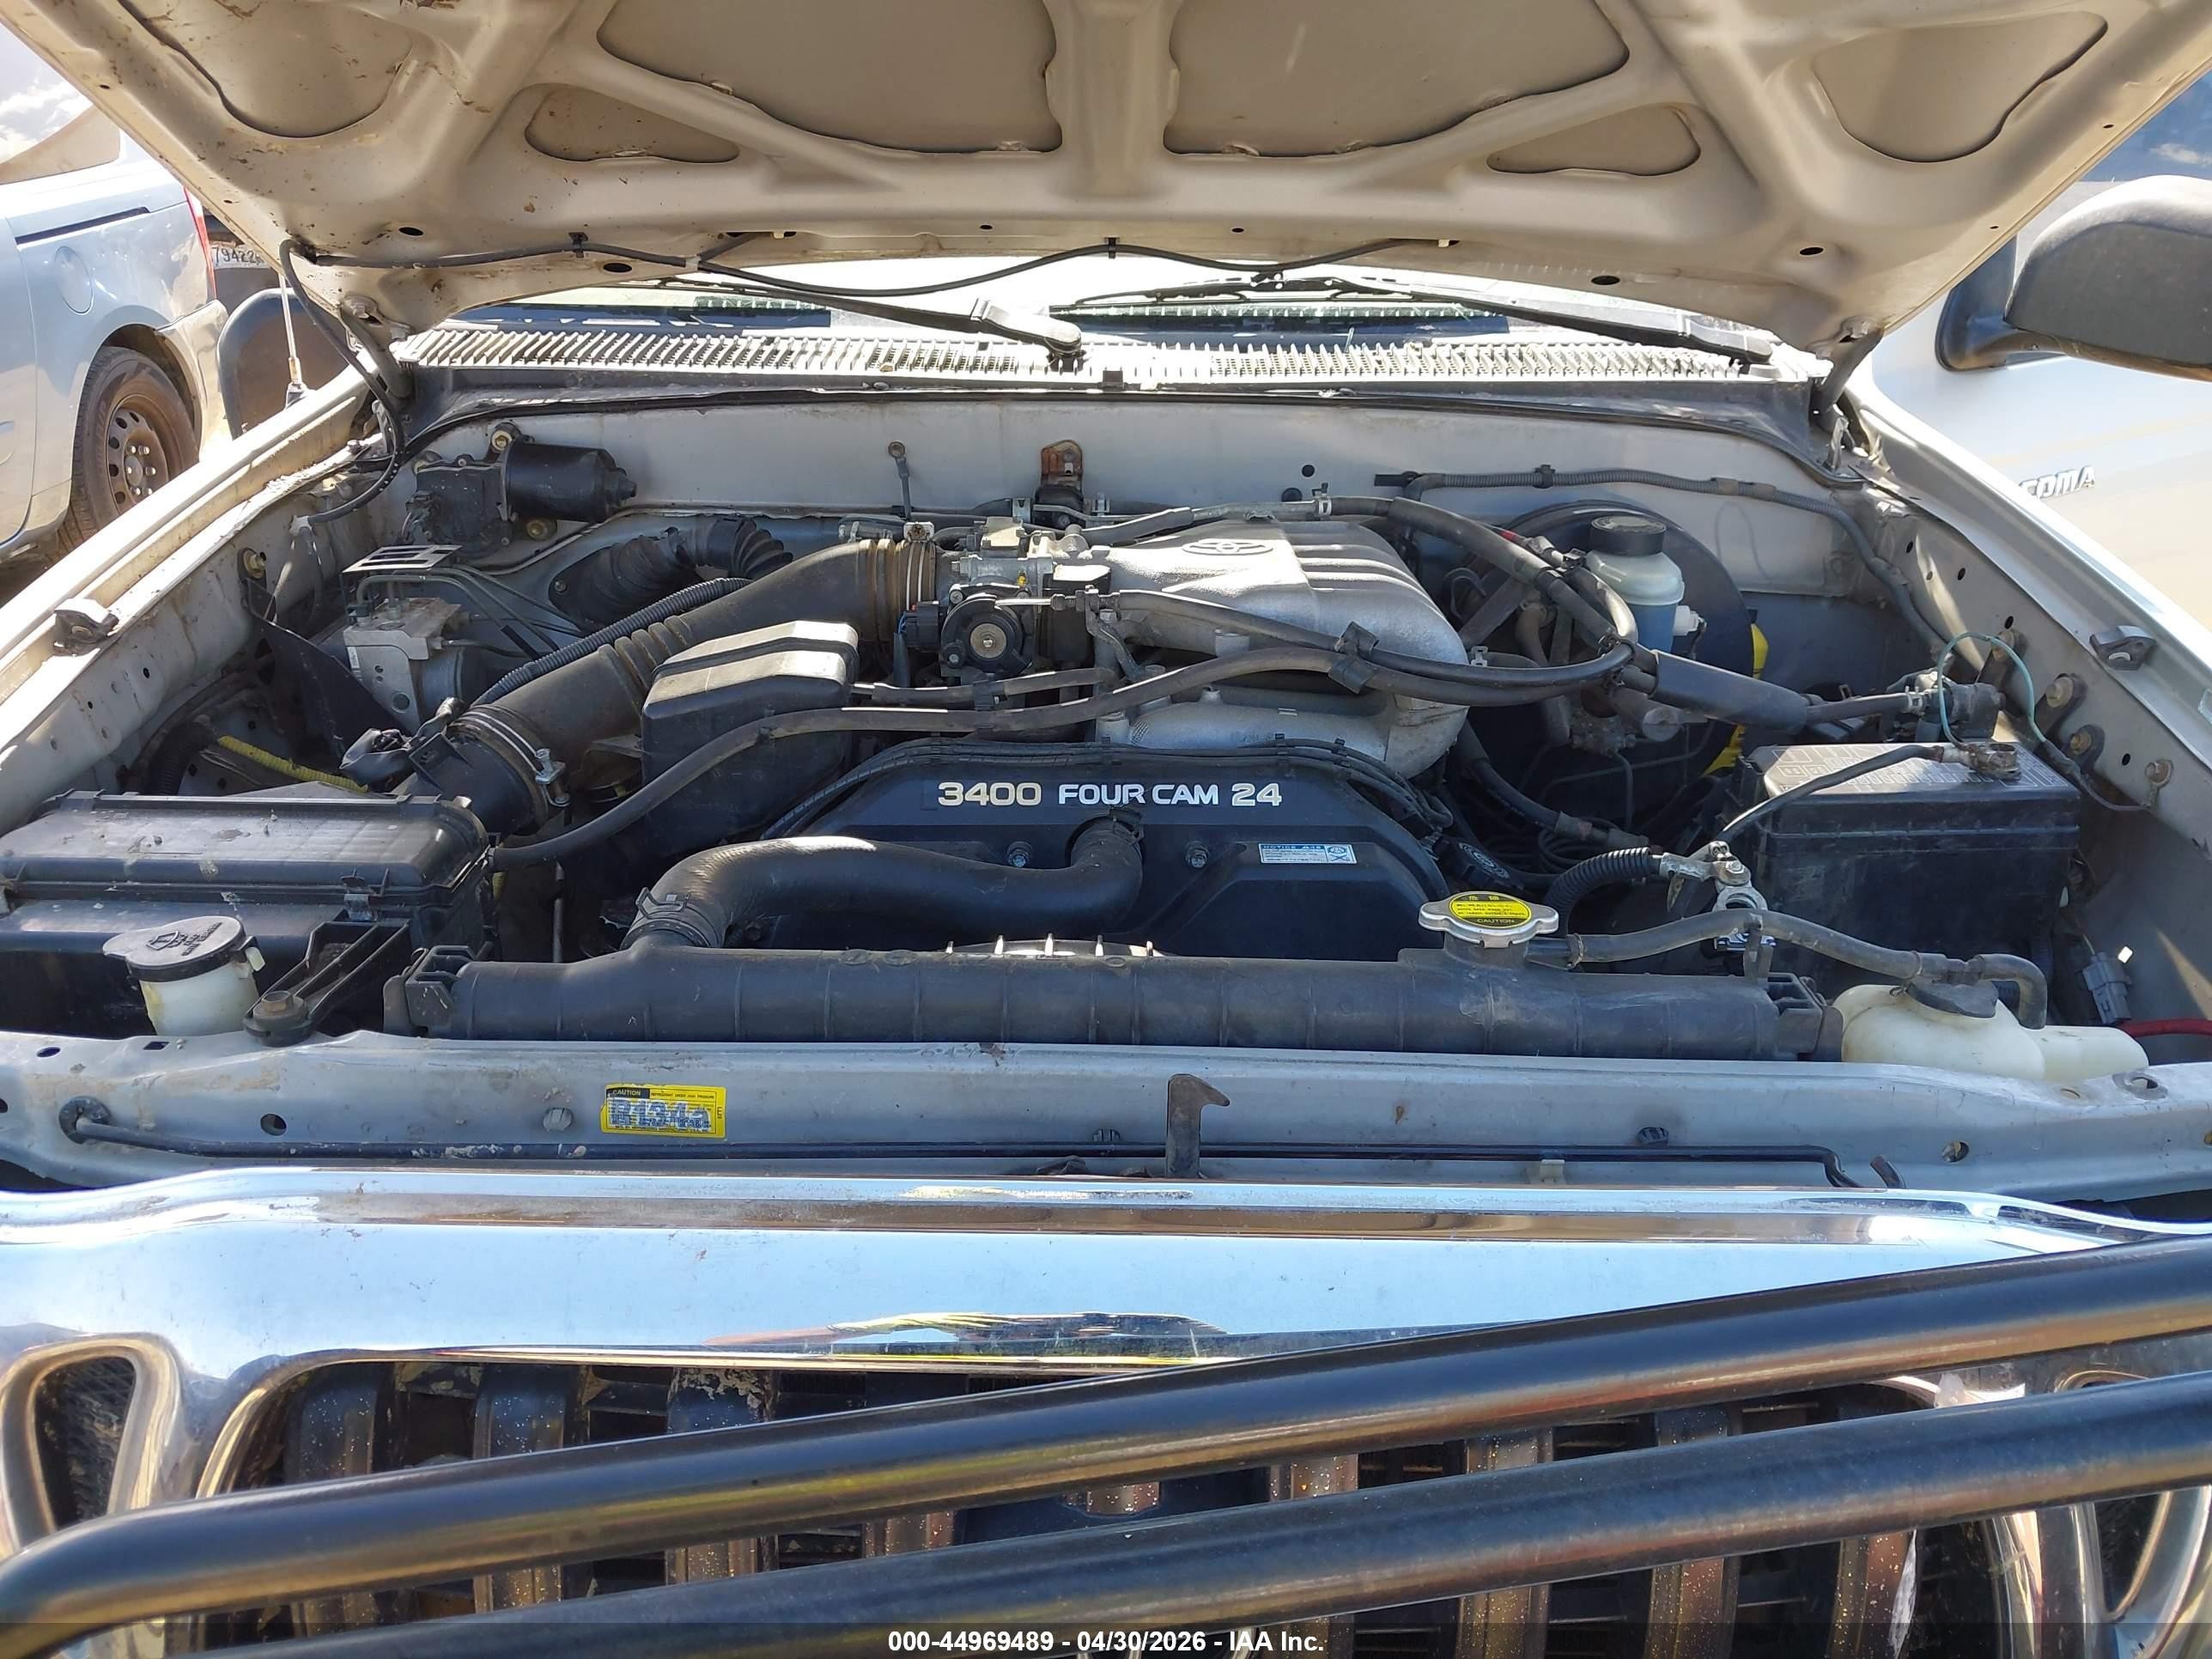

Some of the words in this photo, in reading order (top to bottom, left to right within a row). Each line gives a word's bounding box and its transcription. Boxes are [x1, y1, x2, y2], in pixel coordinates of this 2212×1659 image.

[938, 781, 1042, 806] 3400
[1058, 783, 1146, 805] FOUR
[1152, 784, 1218, 805] CAM
[1231, 782, 1282, 807] 24
